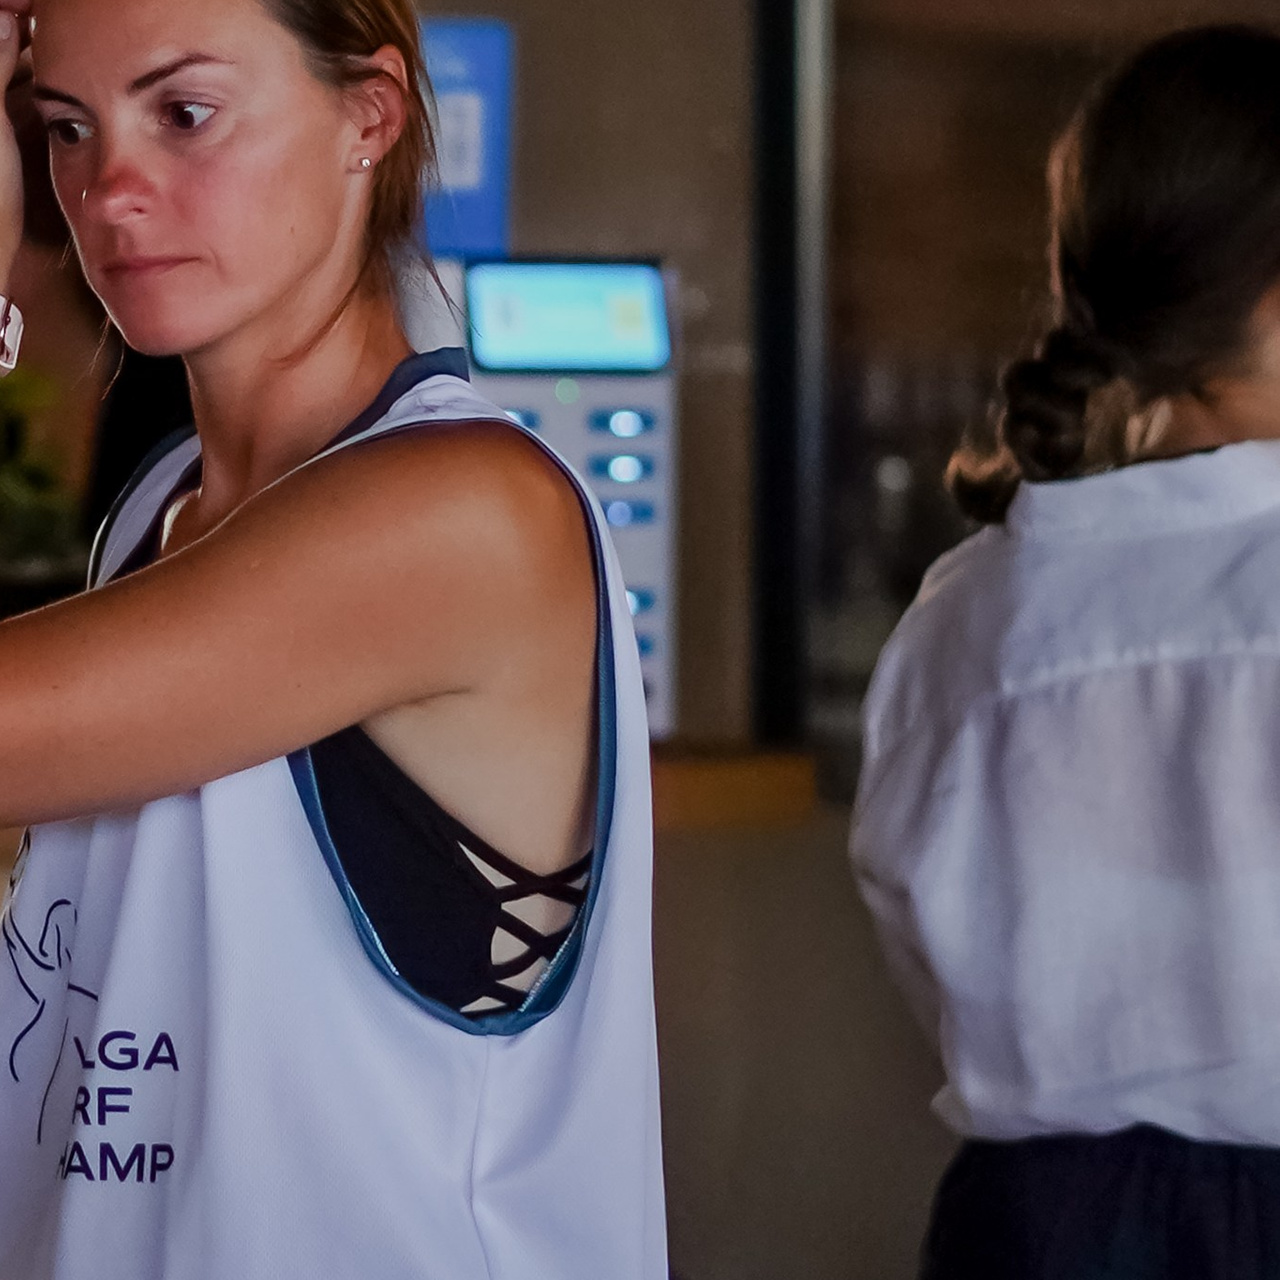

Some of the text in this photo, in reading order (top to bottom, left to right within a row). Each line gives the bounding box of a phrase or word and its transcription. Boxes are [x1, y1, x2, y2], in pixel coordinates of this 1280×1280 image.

[73, 1030, 179, 1071] LGA
[72, 1085, 133, 1125] RF
[59, 1141, 175, 1183] AMP
